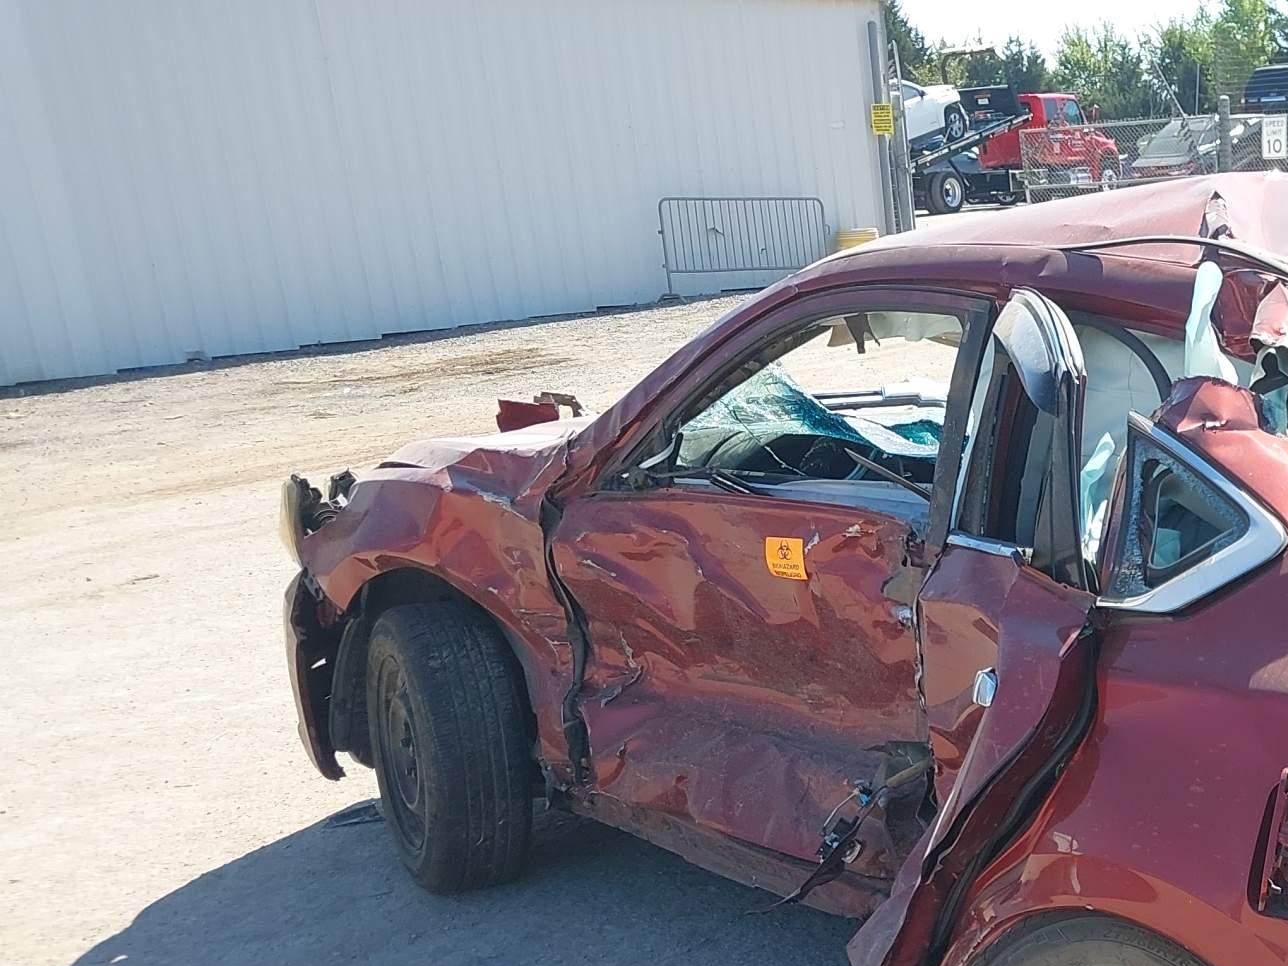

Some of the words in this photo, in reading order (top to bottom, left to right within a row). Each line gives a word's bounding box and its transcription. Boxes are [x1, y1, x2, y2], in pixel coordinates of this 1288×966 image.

[1264, 119, 1284, 128] SPEED
[1266, 129, 1283, 137] LIMIT
[1266, 138, 1283, 154] 10
